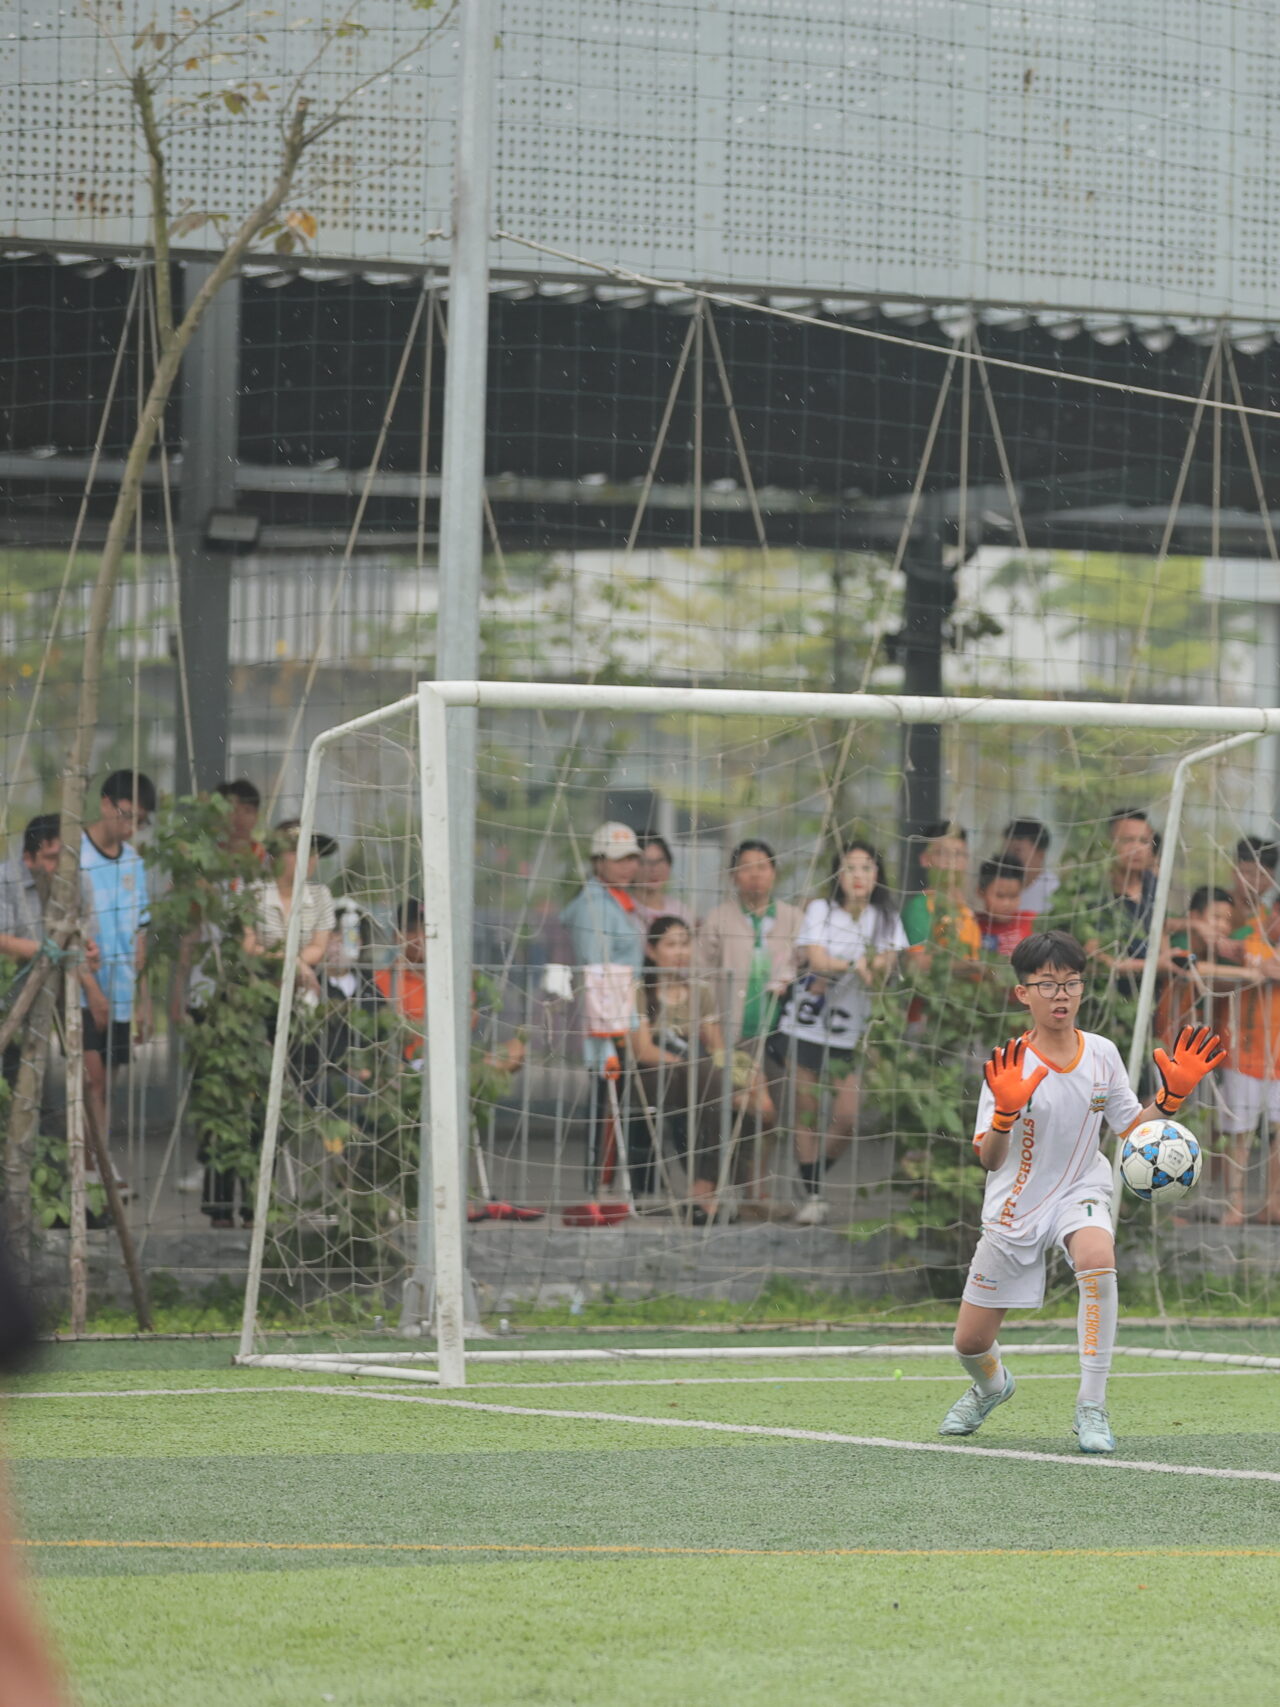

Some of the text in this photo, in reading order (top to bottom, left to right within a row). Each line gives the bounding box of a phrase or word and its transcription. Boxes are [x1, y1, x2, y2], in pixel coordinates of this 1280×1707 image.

[1001, 1118, 1035, 1227] FPT SCHOOLS
[1083, 1278, 1100, 1356] FPT SCHOOLS
